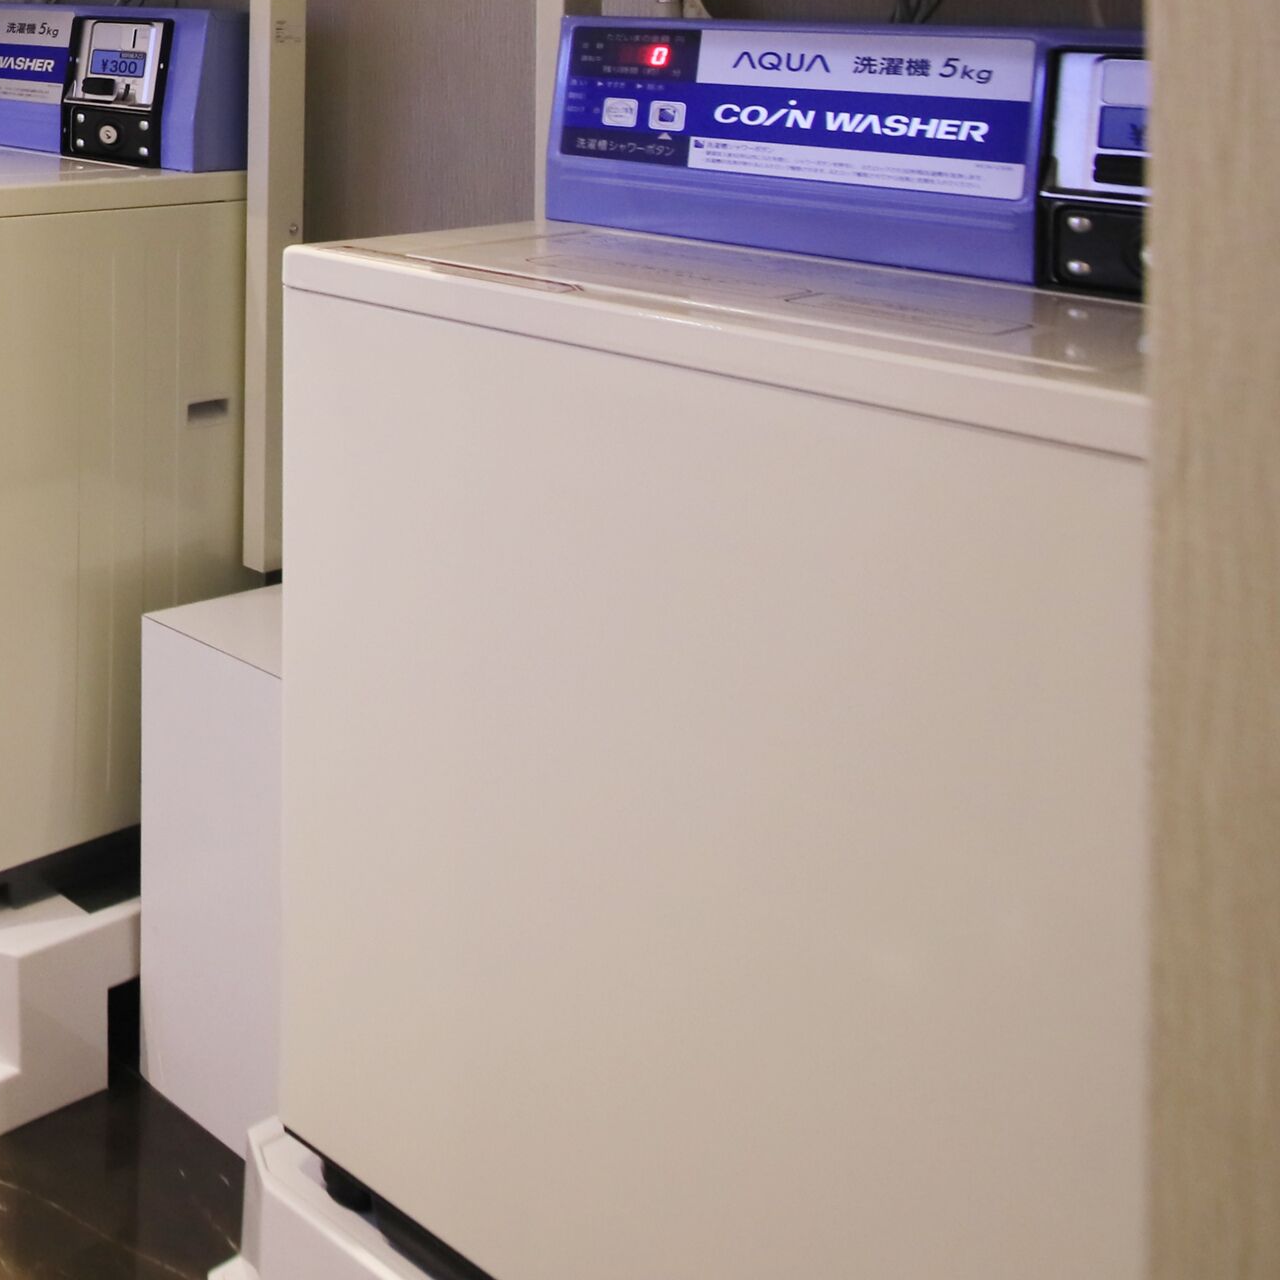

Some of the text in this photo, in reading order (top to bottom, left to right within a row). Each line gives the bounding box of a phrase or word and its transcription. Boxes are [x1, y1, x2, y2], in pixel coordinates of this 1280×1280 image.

[6, 22, 36, 34] 洗濯機
[38, 23, 59, 38] 5kg
[102, 58, 138, 74] ¥300
[651, 47, 669, 66] 0
[733, 51, 994, 84] AQUA 洗濯機 5kg
[714, 100, 990, 143] COIN WASHER
[576, 137, 675, 156] 洗濯槽シャワーボタン
